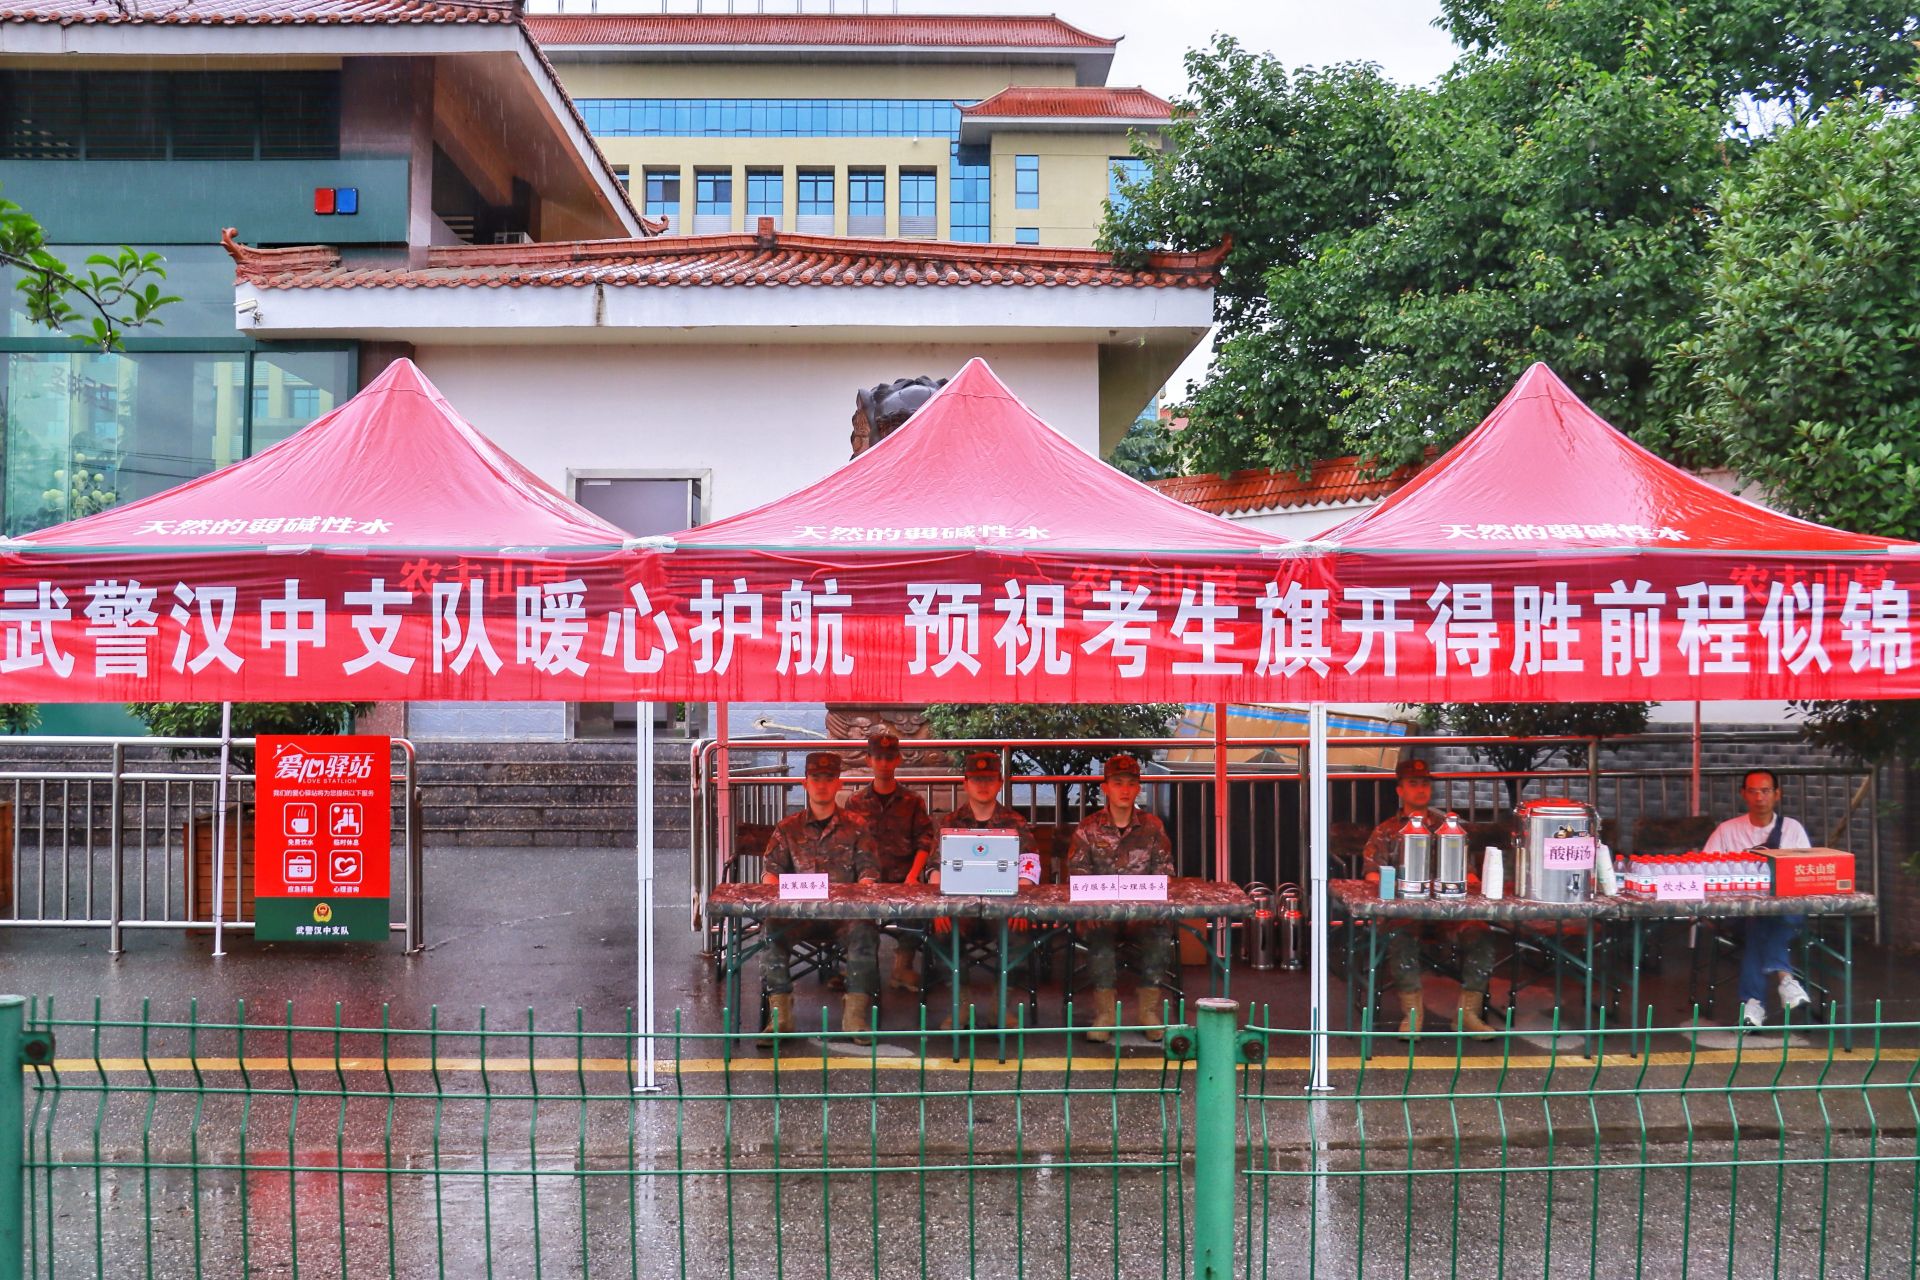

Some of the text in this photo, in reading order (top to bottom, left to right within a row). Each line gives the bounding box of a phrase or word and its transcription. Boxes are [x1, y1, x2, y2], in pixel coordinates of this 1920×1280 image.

[133, 516, 394, 535] 天然的弱碱性水
[790, 524, 1051, 541] 天然的弱碱性水
[1440, 523, 1691, 541] 天然的弱碱性水
[0, 577, 1911, 680] 武警汉中支队暖心护航 预祝考生旗开得胜前程似锦
[275, 753, 374, 783] 爱心驿站
[288, 838, 314, 847] 免费饮水
[333, 838, 360, 847] 临时休息
[1550, 845, 1591, 861] 酸梅汤
[1794, 863, 1836, 876] 农夫山泉
[781, 881, 827, 890] 政策服务点
[1072, 882, 1117, 891] 医疗服务点
[1120, 882, 1165, 891] 心理服务点
[1663, 880, 1699, 892] 饮水点
[296, 926, 349, 935] 武警汉中支队
